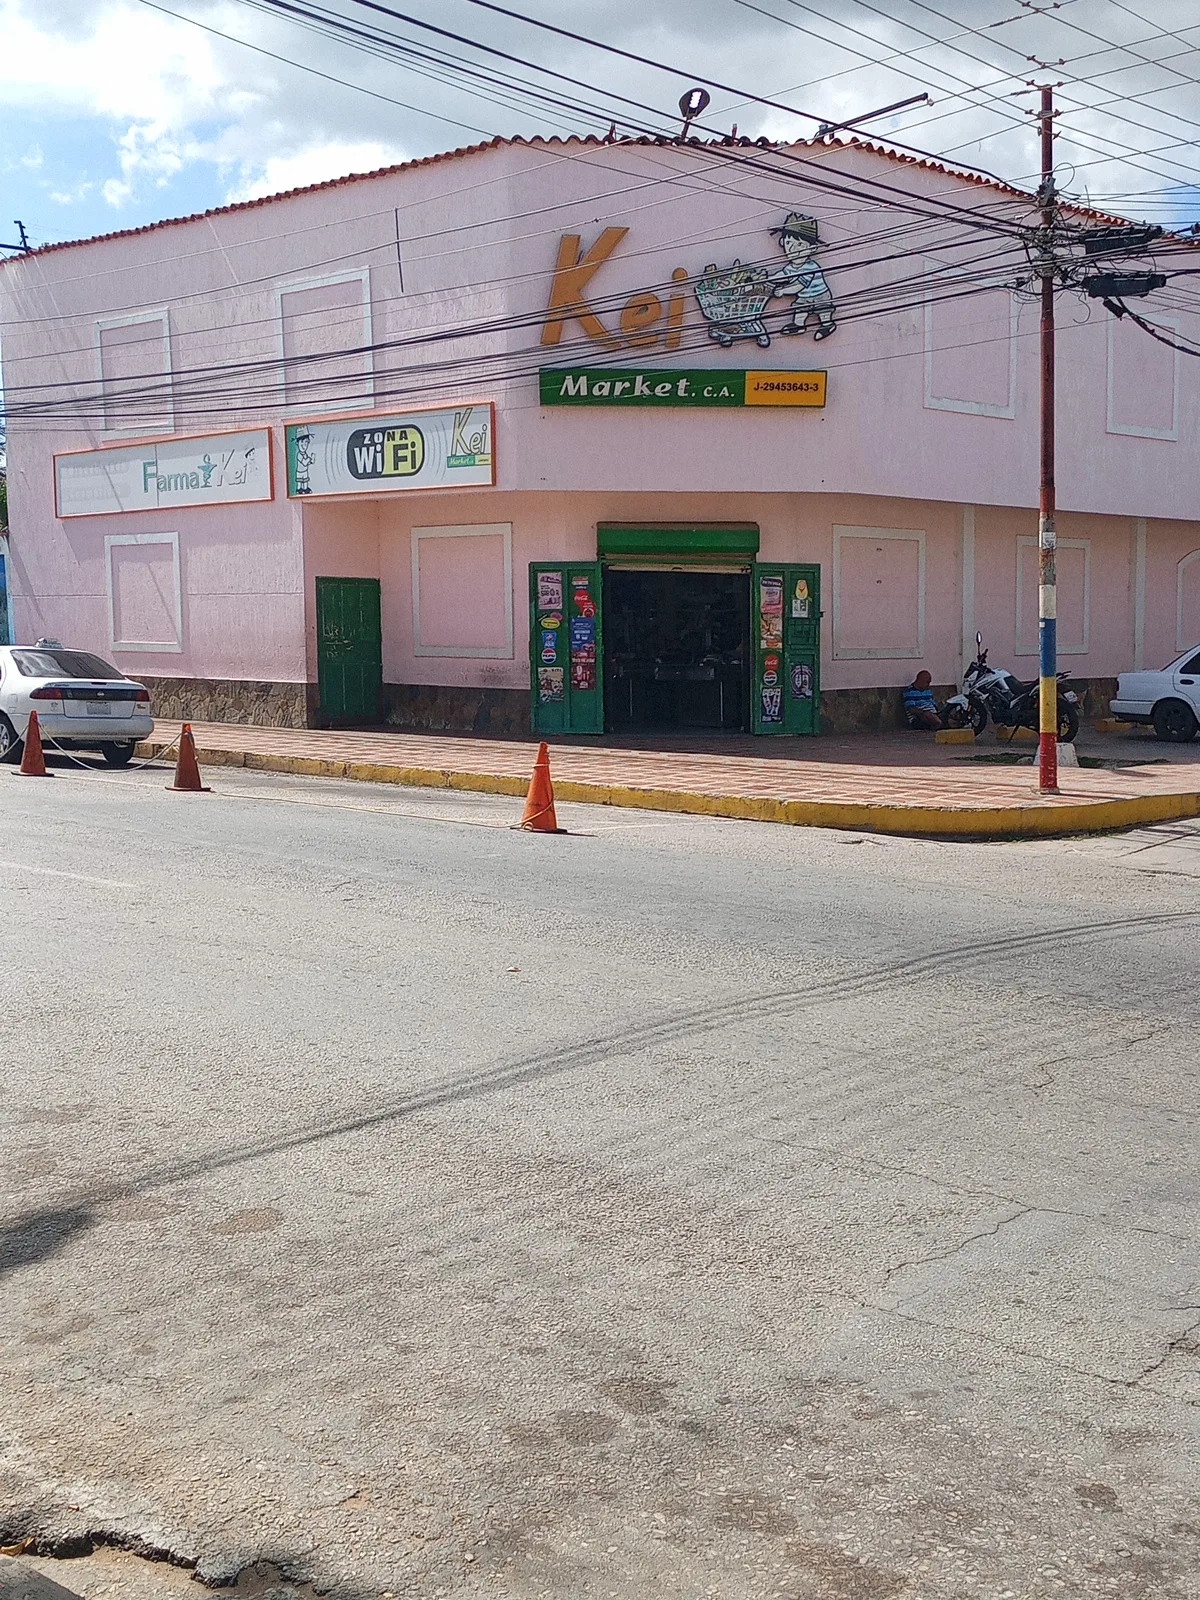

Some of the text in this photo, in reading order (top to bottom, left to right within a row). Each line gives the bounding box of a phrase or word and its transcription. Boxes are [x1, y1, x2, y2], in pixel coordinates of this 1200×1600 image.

[540, 226, 689, 349] Kei
[753, 382, 819, 392] J-29453643-3
[363, 430, 409, 444] ZONA
[450, 407, 488, 456] Kei
[353, 441, 417, 474] WiFi
